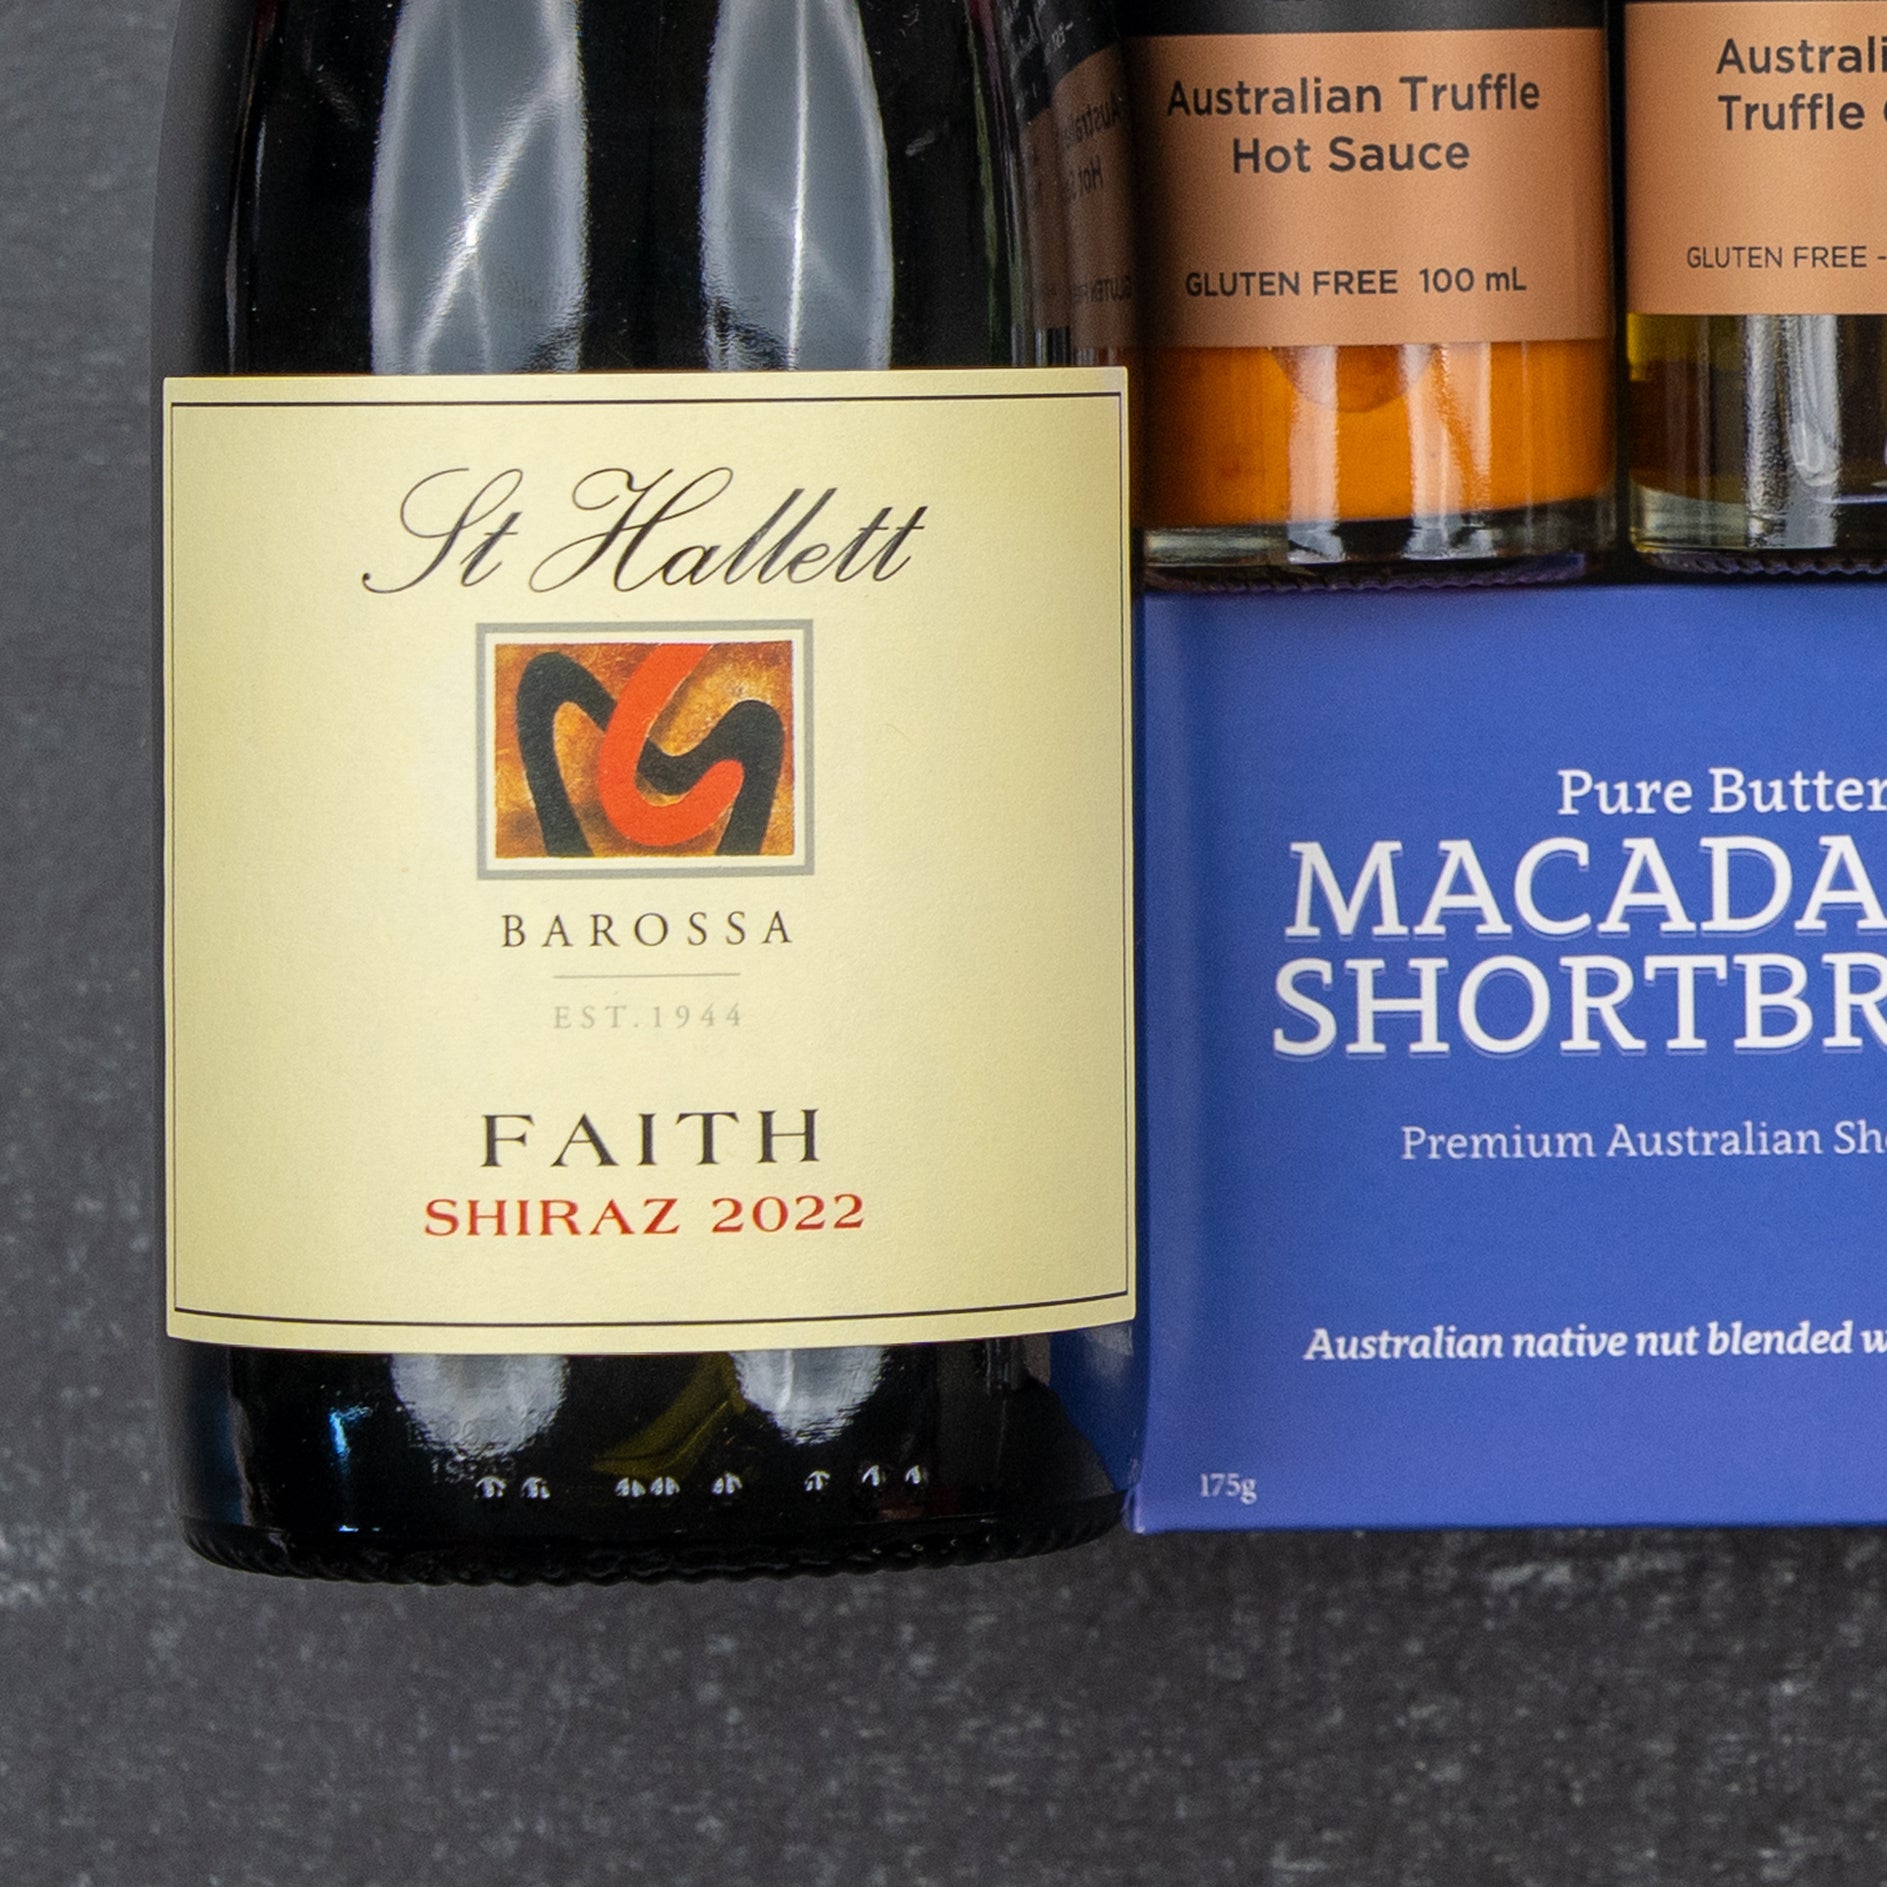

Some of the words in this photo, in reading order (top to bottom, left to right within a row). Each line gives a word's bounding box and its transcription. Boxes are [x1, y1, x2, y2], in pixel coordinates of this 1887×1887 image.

[1717, 36, 1887, 74] Australi
[1167, 77, 1381, 117] Australian
[1400, 73, 1540, 111] Truffle
[1718, 94, 1864, 130] Truffle
[1233, 138, 1310, 173] Hot
[1329, 136, 1469, 172] Sauce
[1687, 246, 1781, 268] GLUTEN
[1794, 246, 1866, 267] FREE
[1185, 270, 1301, 298] GLUTEN
[1314, 270, 1397, 294] FREE
[1420, 268, 1474, 292] 100
[1486, 267, 1526, 291] mL
[362, 469, 522, 593] St
[528, 467, 928, 592] Hallett
[1558, 770, 1692, 814] Pure
[1709, 768, 1887, 812] Butter
[1286, 836, 1887, 935] MACADA
[503, 911, 790, 947] BAROSSA
[555, 1003, 740, 1028] EST.1944
[1275, 953, 1887, 1054] SHORTBR
[482, 1109, 818, 1167] FAITH
[1403, 1125, 1595, 1159] Premium
[1607, 1121, 1822, 1156] Australian
[1835, 1119, 1887, 1155] Sh
[425, 1199, 678, 1235] SHIRAZ
[712, 1194, 862, 1233] 2022
[1304, 1326, 1502, 1359] Australian
[1513, 1324, 1627, 1357] native
[1636, 1327, 1699, 1356] nut
[1708, 1321, 1852, 1355] blended
[1202, 1474, 1256, 1504] 175g
